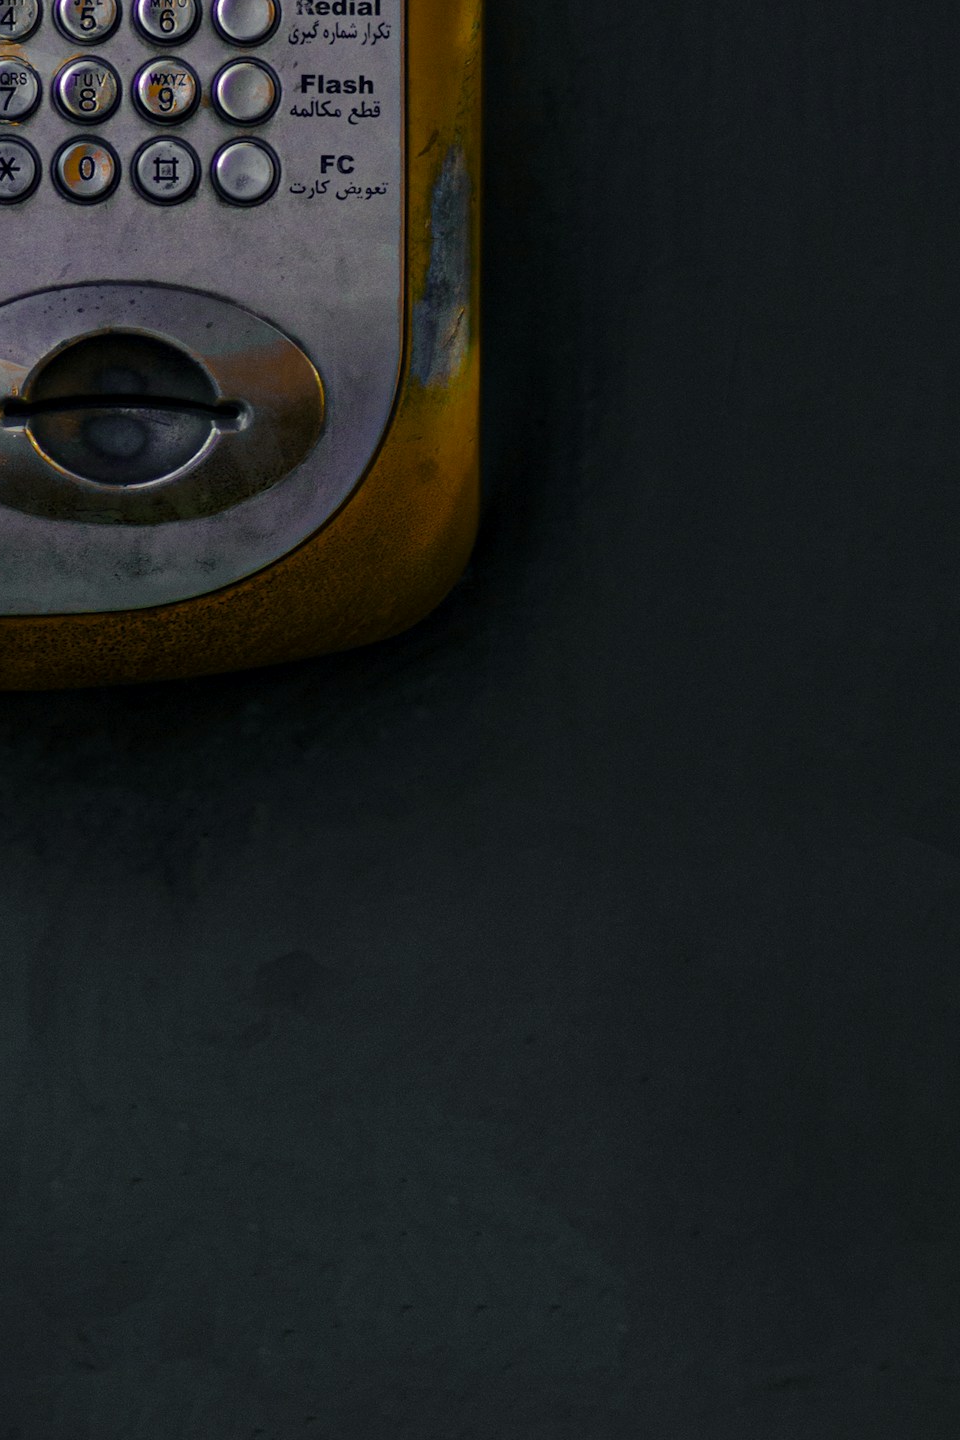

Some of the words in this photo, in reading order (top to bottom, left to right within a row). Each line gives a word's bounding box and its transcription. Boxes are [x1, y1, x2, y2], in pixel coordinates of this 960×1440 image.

[0, 9, 17, 32] 4
[79, 7, 97, 32] 5
[158, 8, 176, 34] 6
[322, 21, 358, 45] شماره
[361, 22, 392, 45] تکرار
[301, 74, 374, 94] Flash
[0, 86, 17, 111] 7
[78, 87, 97, 112] 8
[158, 87, 176, 112] 9
[289, 100, 342, 118] مکالمه
[348, 101, 381, 125] قطع
[78, 156, 96, 181] 0
[320, 155, 355, 174] FC
[289, 180, 331, 199] کارت
[336, 182, 389, 200] تعویض
